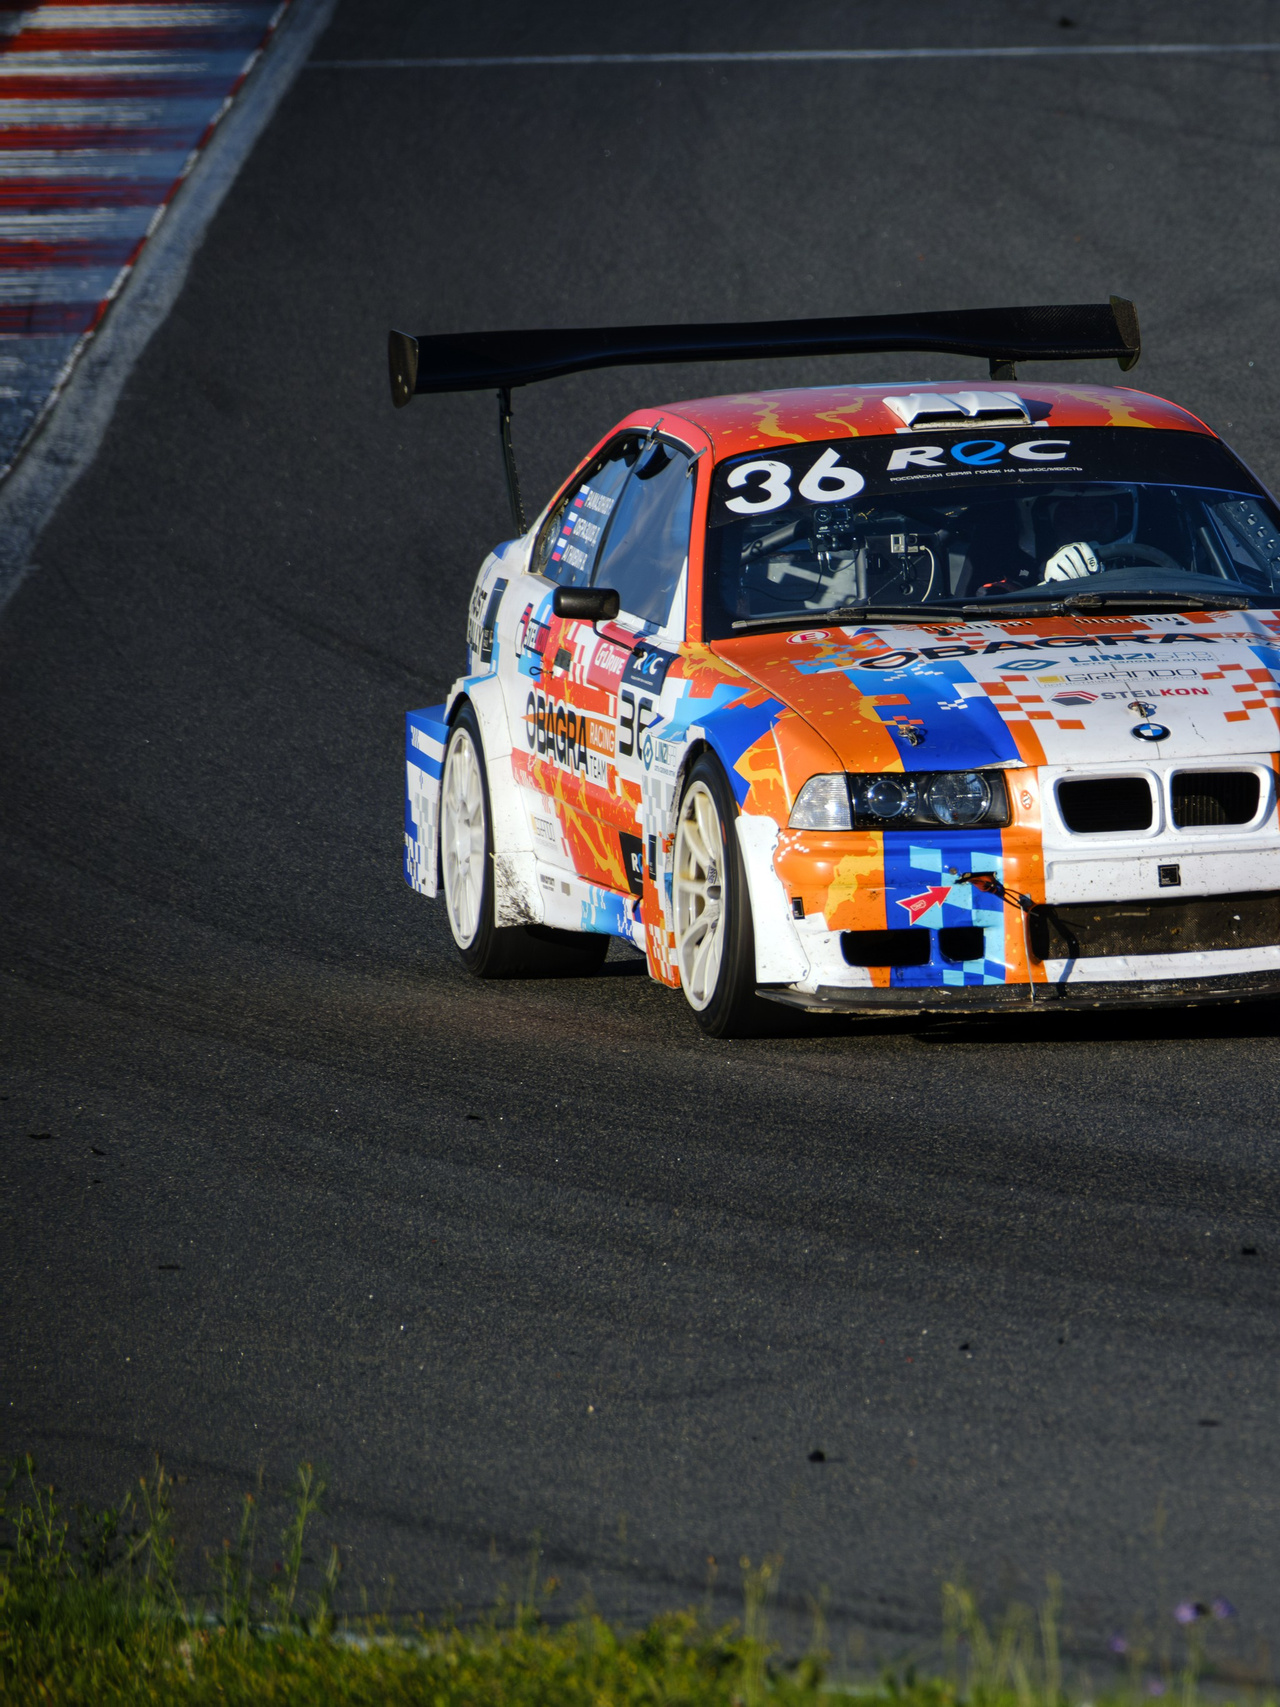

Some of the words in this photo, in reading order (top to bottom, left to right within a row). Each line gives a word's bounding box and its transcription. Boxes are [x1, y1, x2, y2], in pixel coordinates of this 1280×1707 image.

[725, 447, 865, 514] 36
[889, 472, 943, 482] РОССИЙСКАЯ
[858, 632, 1219, 670] OBAGRA
[1100, 687, 1210, 700] STELKON
[526, 690, 588, 775] OBAGRA
[589, 721, 615, 752] RACING
[589, 755, 608, 783] TEAM
